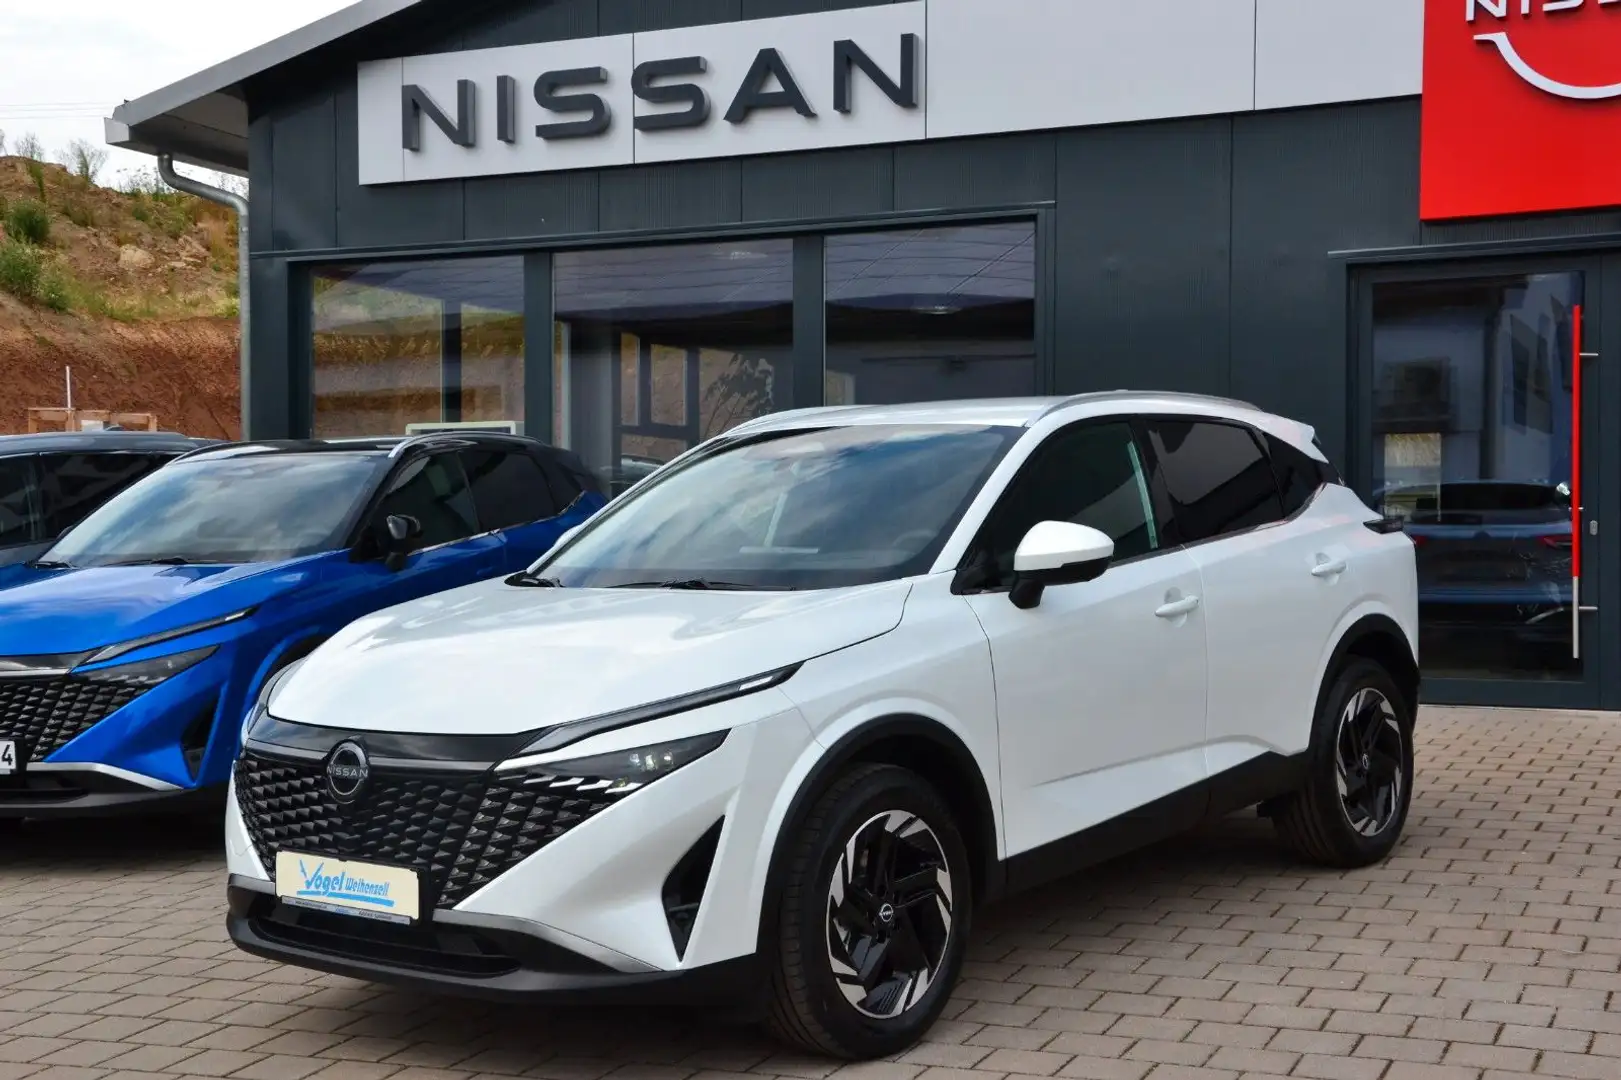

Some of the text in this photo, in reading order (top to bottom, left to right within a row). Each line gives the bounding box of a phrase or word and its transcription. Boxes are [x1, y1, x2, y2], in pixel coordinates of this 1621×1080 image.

[401, 33, 919, 152] NISSAN
[326, 765, 369, 778] NISSAN
[299, 859, 390, 897] Vogel Weihenzell
